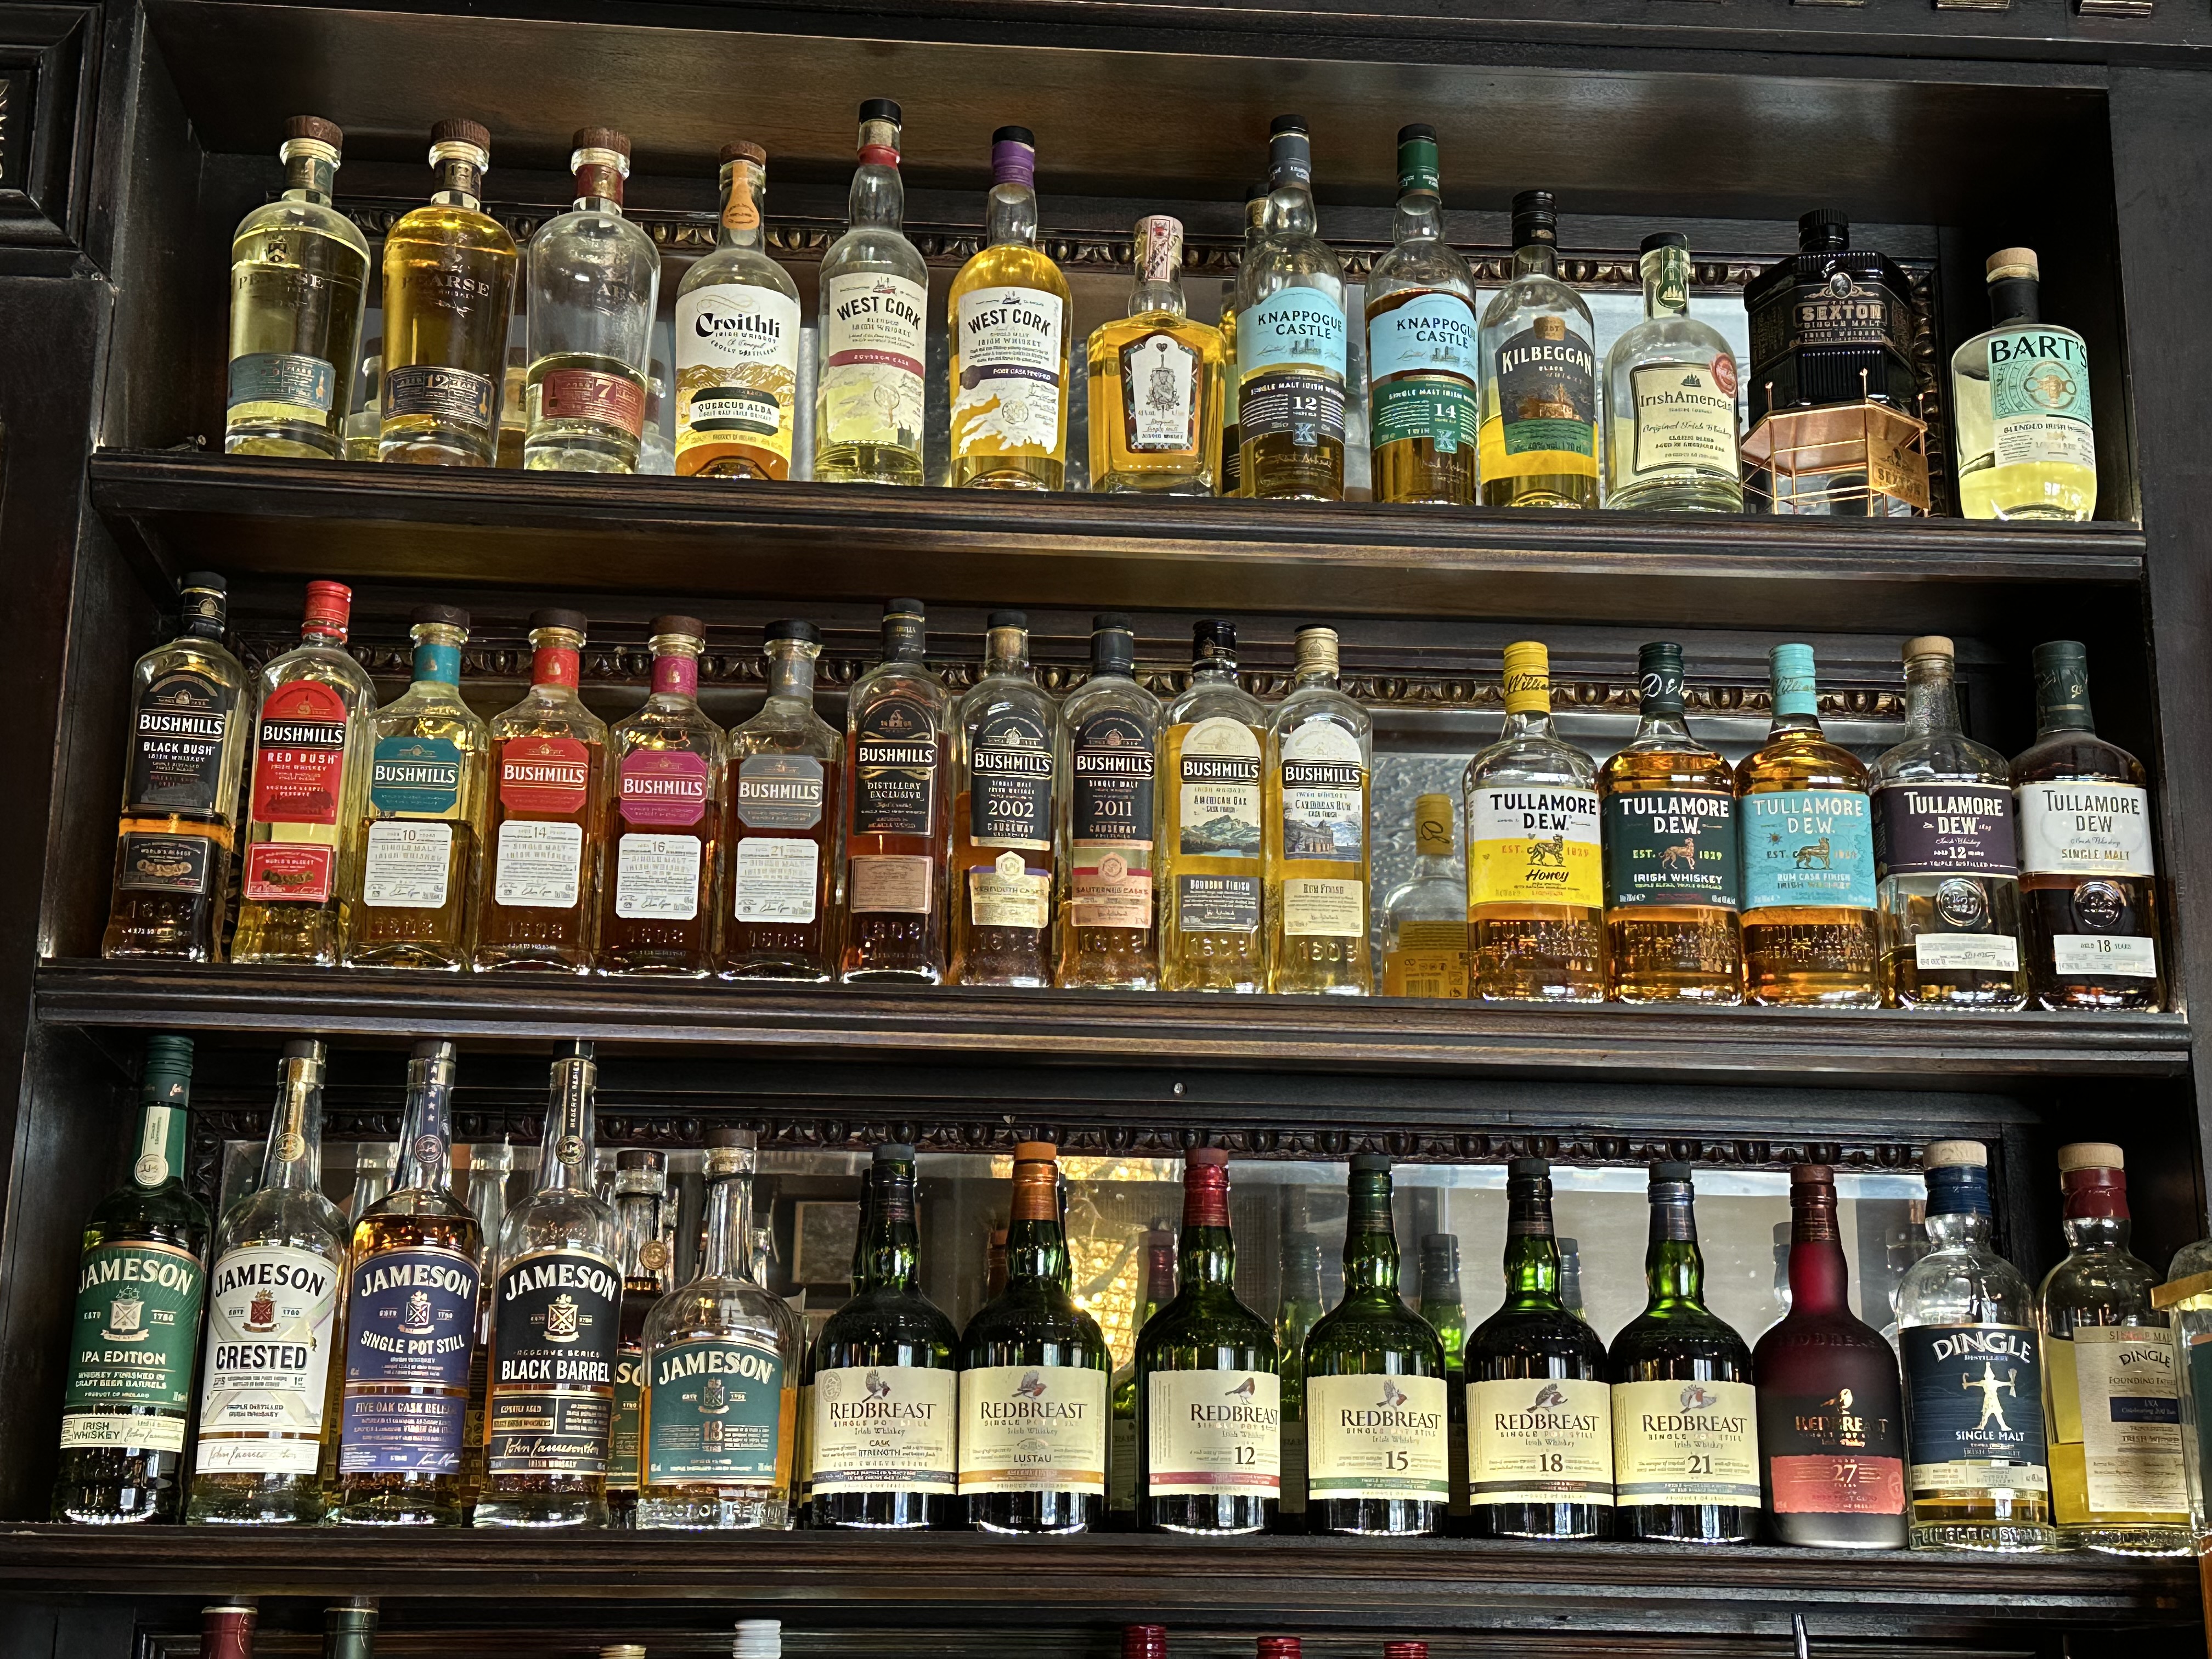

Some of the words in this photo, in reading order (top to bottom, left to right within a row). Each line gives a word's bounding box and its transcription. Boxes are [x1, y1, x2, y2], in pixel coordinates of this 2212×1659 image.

[837, 297, 879, 321] WEST
[885, 298, 921, 330] CORK
[1258, 310, 1342, 333] KNAPPOGUE
[1802, 304, 1882, 321] SEXTON
[696, 313, 780, 338] Croithli
[968, 308, 1007, 334] WEST
[1012, 308, 1051, 336] CORK
[1276, 324, 1331, 340] CASTLE
[1416, 330, 1469, 349] CASTLE
[1502, 346, 1592, 377] KILBEGGAN
[1991, 336, 2087, 369] BART'S
[596, 379, 616, 398] 7
[1293, 396, 1317, 410] 12
[1434, 403, 1457, 419] 14
[1640, 391, 1733, 413] IrishAmerican
[139, 714, 224, 736] BUSHMILLS
[263, 726, 343, 743] BUSHMILLS
[144, 741, 178, 754] BLACK
[183, 744, 213, 755] BUSH
[859, 747, 934, 763] BUSHMILLS
[267, 752, 291, 763] RED
[300, 754, 335, 765] BUSH
[974, 753, 1052, 772] BUSHMILLS
[1077, 755, 1153, 772] BUSHMILLS
[375, 765, 456, 784] BUSHMILLS
[504, 765, 585, 784] BUSHMILLS
[1183, 761, 1259, 778] BUSHMILLS
[1285, 765, 1361, 783] BUSHMILLS
[624, 778, 703, 797] BUSHMILLS
[740, 782, 821, 800] BUSHMILLS
[988, 800, 1035, 817] 2002
[1093, 800, 1132, 816] 2011
[1490, 793, 1596, 815] TULLAMORE
[1620, 797, 1729, 817] TULLAMORE
[1753, 797, 1864, 816] TULLAMORE
[1904, 791, 2004, 816] TULLAMORE
[2042, 790, 2140, 815] TULLAMORE
[1523, 814, 1569, 831] D.E.W.
[1654, 816, 1701, 834] D.E.W.
[403, 830, 416, 841] 10
[534, 827, 546, 839] 14
[653, 841, 665, 853] 16
[1633, 849, 1655, 859] EST.
[1949, 847, 1966, 859] 12
[2062, 849, 2100, 859] SINGLE
[2104, 850, 2130, 861] MALT
[1525, 869, 1570, 882] Honey
[1634, 873, 1666, 883] IRISH
[1671, 873, 1723, 884] WHISKEY
[2097, 939, 2112, 952] 18
[78, 1257, 194, 1296] JAMESON
[215, 1263, 325, 1298] JAMESON
[361, 1265, 472, 1299] JAMESON
[506, 1264, 617, 1301] JAMESON
[361, 1330, 405, 1353] SINGLE
[408, 1340, 435, 1355] POT
[436, 1334, 465, 1353] STILL
[1932, 1331, 2031, 1363] DINGLE
[82, 1351, 99, 1363] IPA
[104, 1351, 166, 1365] EDITION
[216, 1345, 307, 1370] CRESTED
[2119, 1350, 2171, 1368] DINGLE
[501, 1359, 551, 1381] BLACK
[556, 1359, 610, 1383] BARREL
[659, 1351, 773, 1385] JAMESON
[376, 1402, 395, 1412] OAK
[397, 1403, 423, 1414] CASK
[830, 1402, 936, 1420] REDBREAST
[981, 1401, 1087, 1419] REDBREAST
[1191, 1403, 1278, 1425] REDBREAST
[83, 1421, 110, 1431] IRISH
[1341, 1409, 1442, 1429] REDBREAST
[1495, 1413, 1600, 1431] REDBREAST
[1642, 1415, 1747, 1433] REDBREAST
[74, 1431, 120, 1440] WHISKEY
[703, 1421, 723, 1441] 18
[1956, 1430, 1994, 1441] SINGLE
[1999, 1431, 2024, 1442] MALT
[1014, 1454, 1052, 1463] LUSTAU
[1235, 1446, 1255, 1465] 12
[1385, 1451, 1409, 1471] 15
[1539, 1453, 1564, 1472] 18
[1688, 1455, 1713, 1475] 21
[1832, 1464, 1858, 1483] 27
